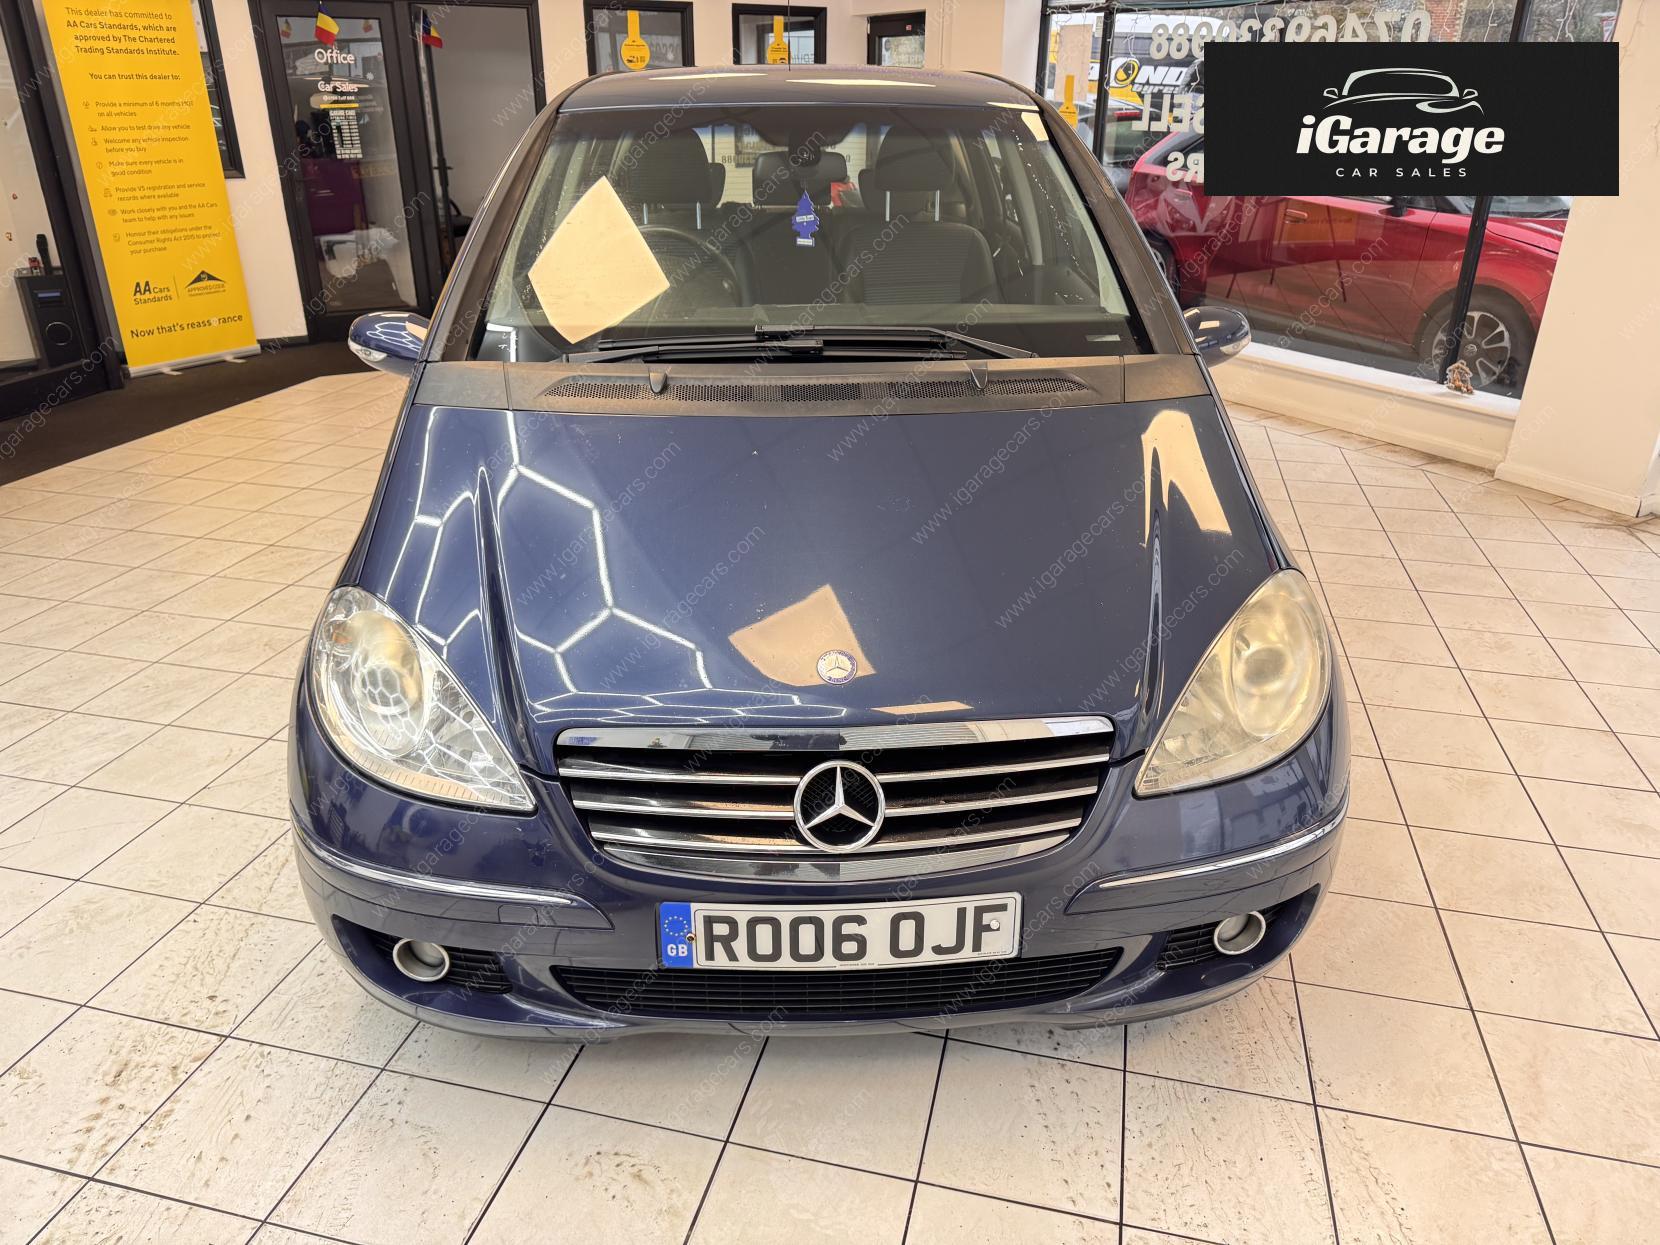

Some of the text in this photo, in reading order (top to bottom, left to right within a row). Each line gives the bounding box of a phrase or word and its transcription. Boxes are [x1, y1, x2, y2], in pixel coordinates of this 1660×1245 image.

[65, 7, 82, 15] This
[84, 8, 108, 17] dealer
[109, 9, 123, 17] has
[124, 11, 163, 20] committed
[66, 20, 79, 28] AA
[80, 21, 97, 29] Cars
[98, 21, 141, 31] Standards,
[142, 23, 164, 32] which
[74, 34, 111, 42] approved
[112, 34, 122, 43] by
[138, 36, 176, 44] Chartered
[75, 46, 104, 55] Trading
[106, 47, 144, 55] Standards
[314, 48, 355, 64] Office
[318, 81, 358, 92] Car Sales
[146, 184, 176, 192] registration
[144, 246, 167, 254] purchase
[133, 281, 152, 296] AA
[134, 294, 173, 305] Standards
[130, 314, 243, 339] Now that's reassrance
[667, 943, 688, 957] GB
